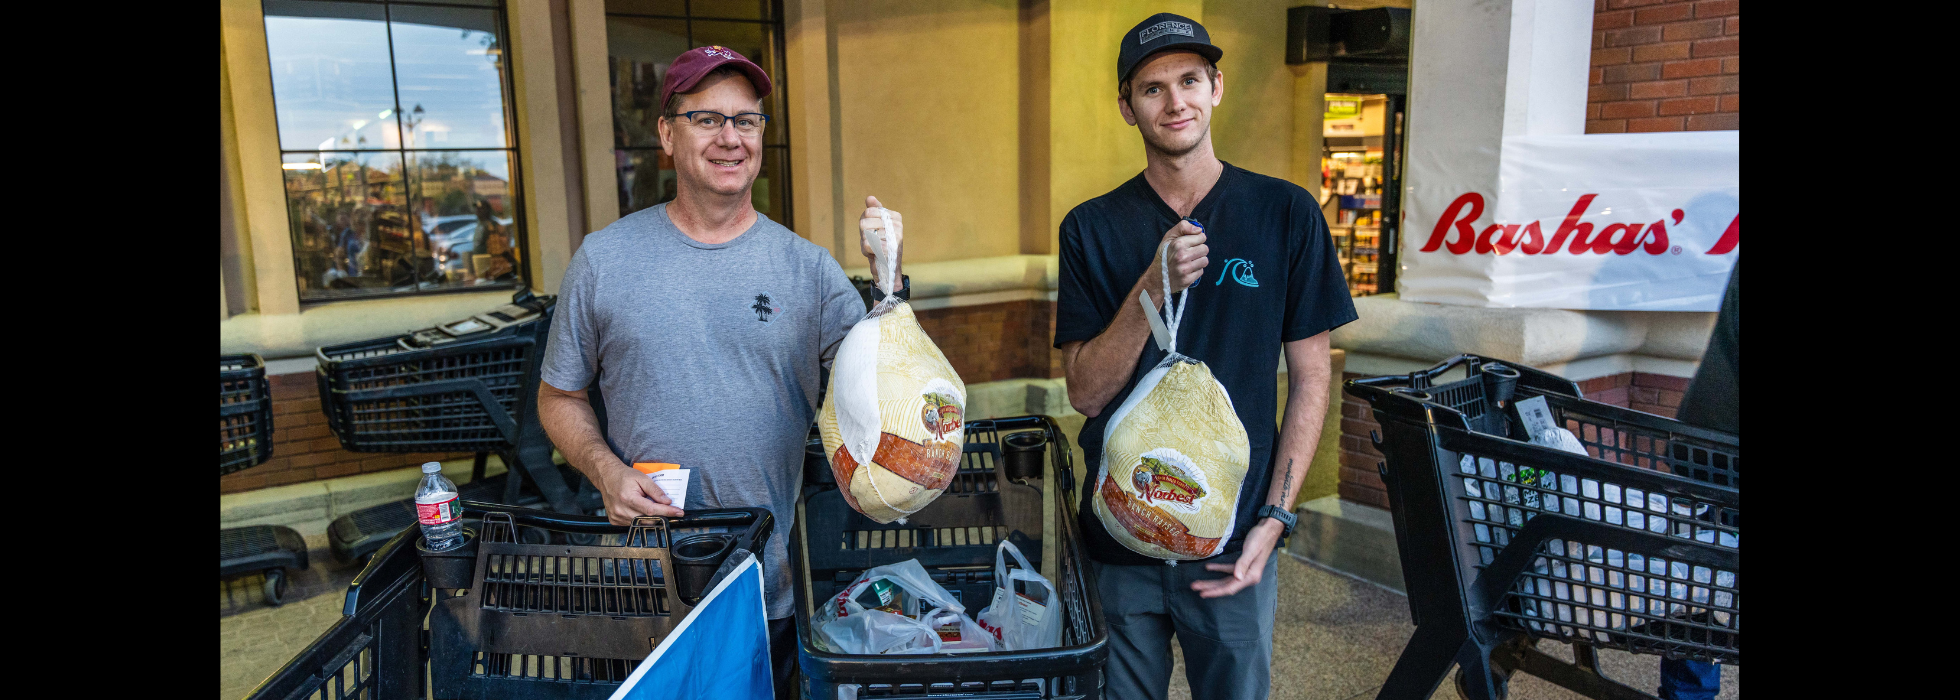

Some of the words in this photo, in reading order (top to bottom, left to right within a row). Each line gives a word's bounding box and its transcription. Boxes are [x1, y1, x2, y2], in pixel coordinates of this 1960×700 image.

[1141, 22, 1191, 38] FLORENCE
[1419, 192, 1685, 256] Bashas'
[1137, 482, 1197, 505] Norbest
[1127, 499, 1152, 519] RANCH
